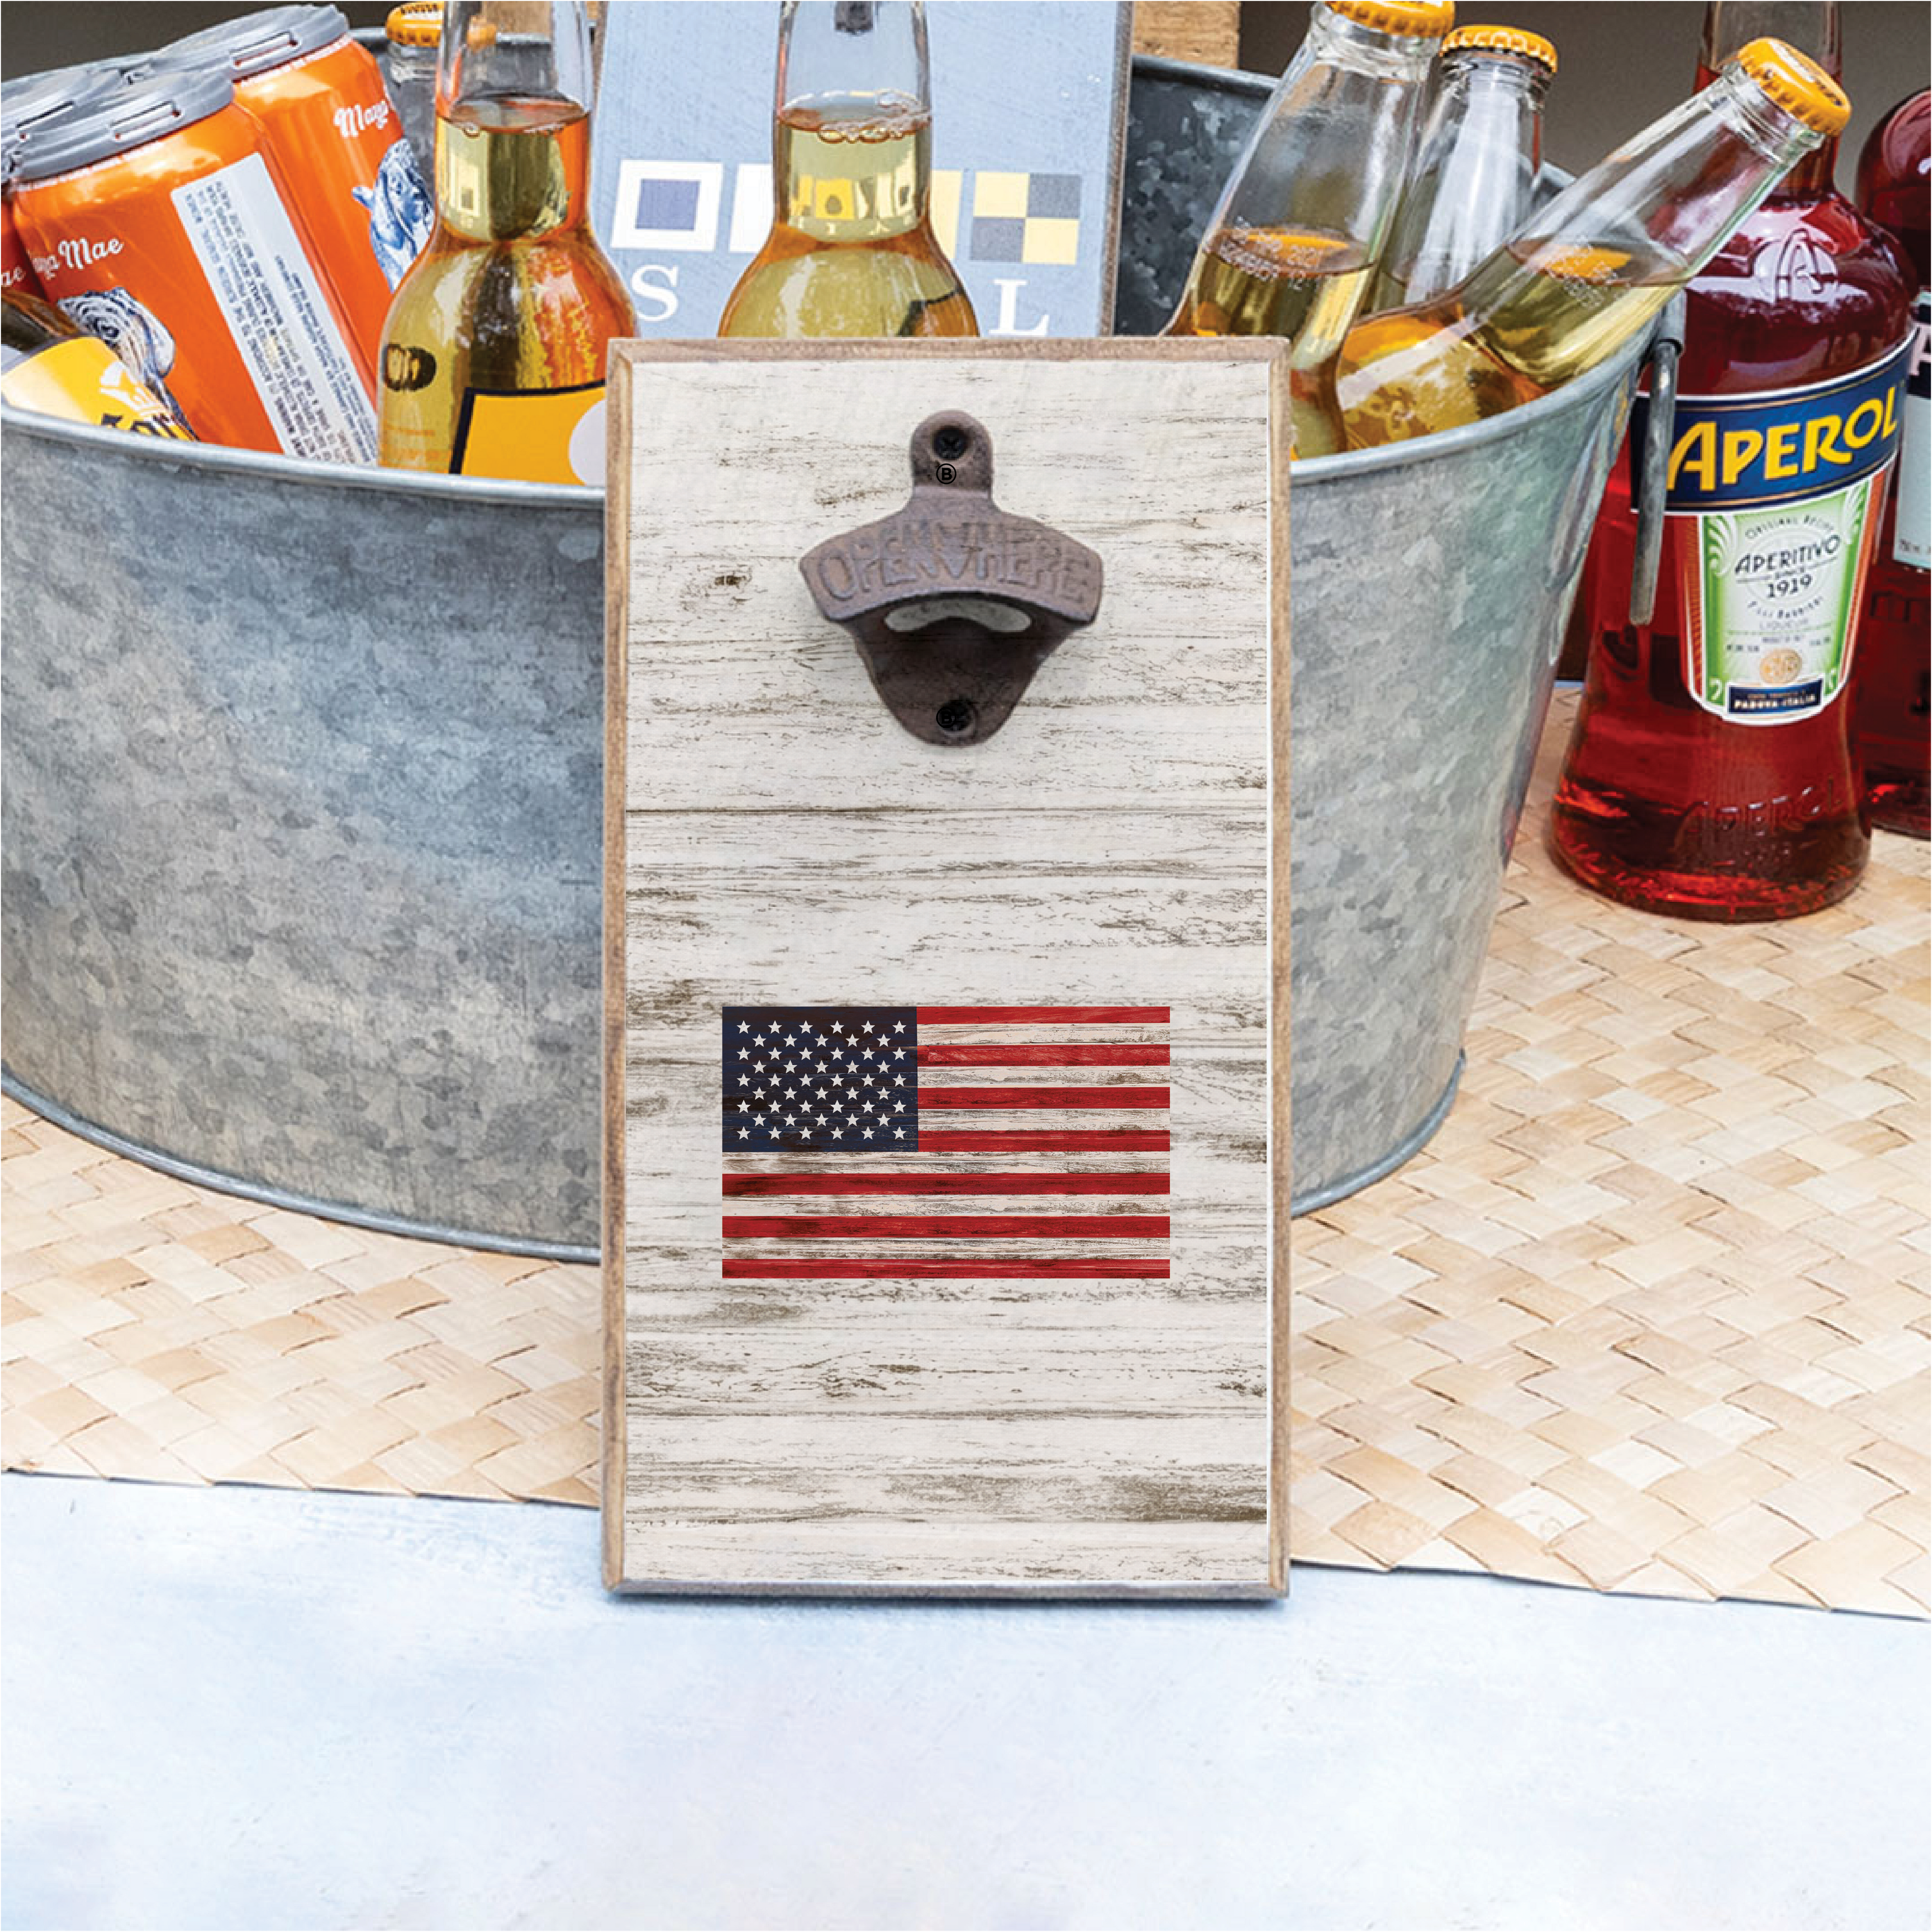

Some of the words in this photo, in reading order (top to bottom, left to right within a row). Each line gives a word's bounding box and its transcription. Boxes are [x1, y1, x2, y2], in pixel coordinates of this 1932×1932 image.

[57, 236, 125, 270] Mae
[989, 279, 1050, 336] L
[1665, 386, 1897, 492] APEROL
[1735, 534, 1841, 575] APERITIVO
[1767, 574, 1813, 598] 1919
